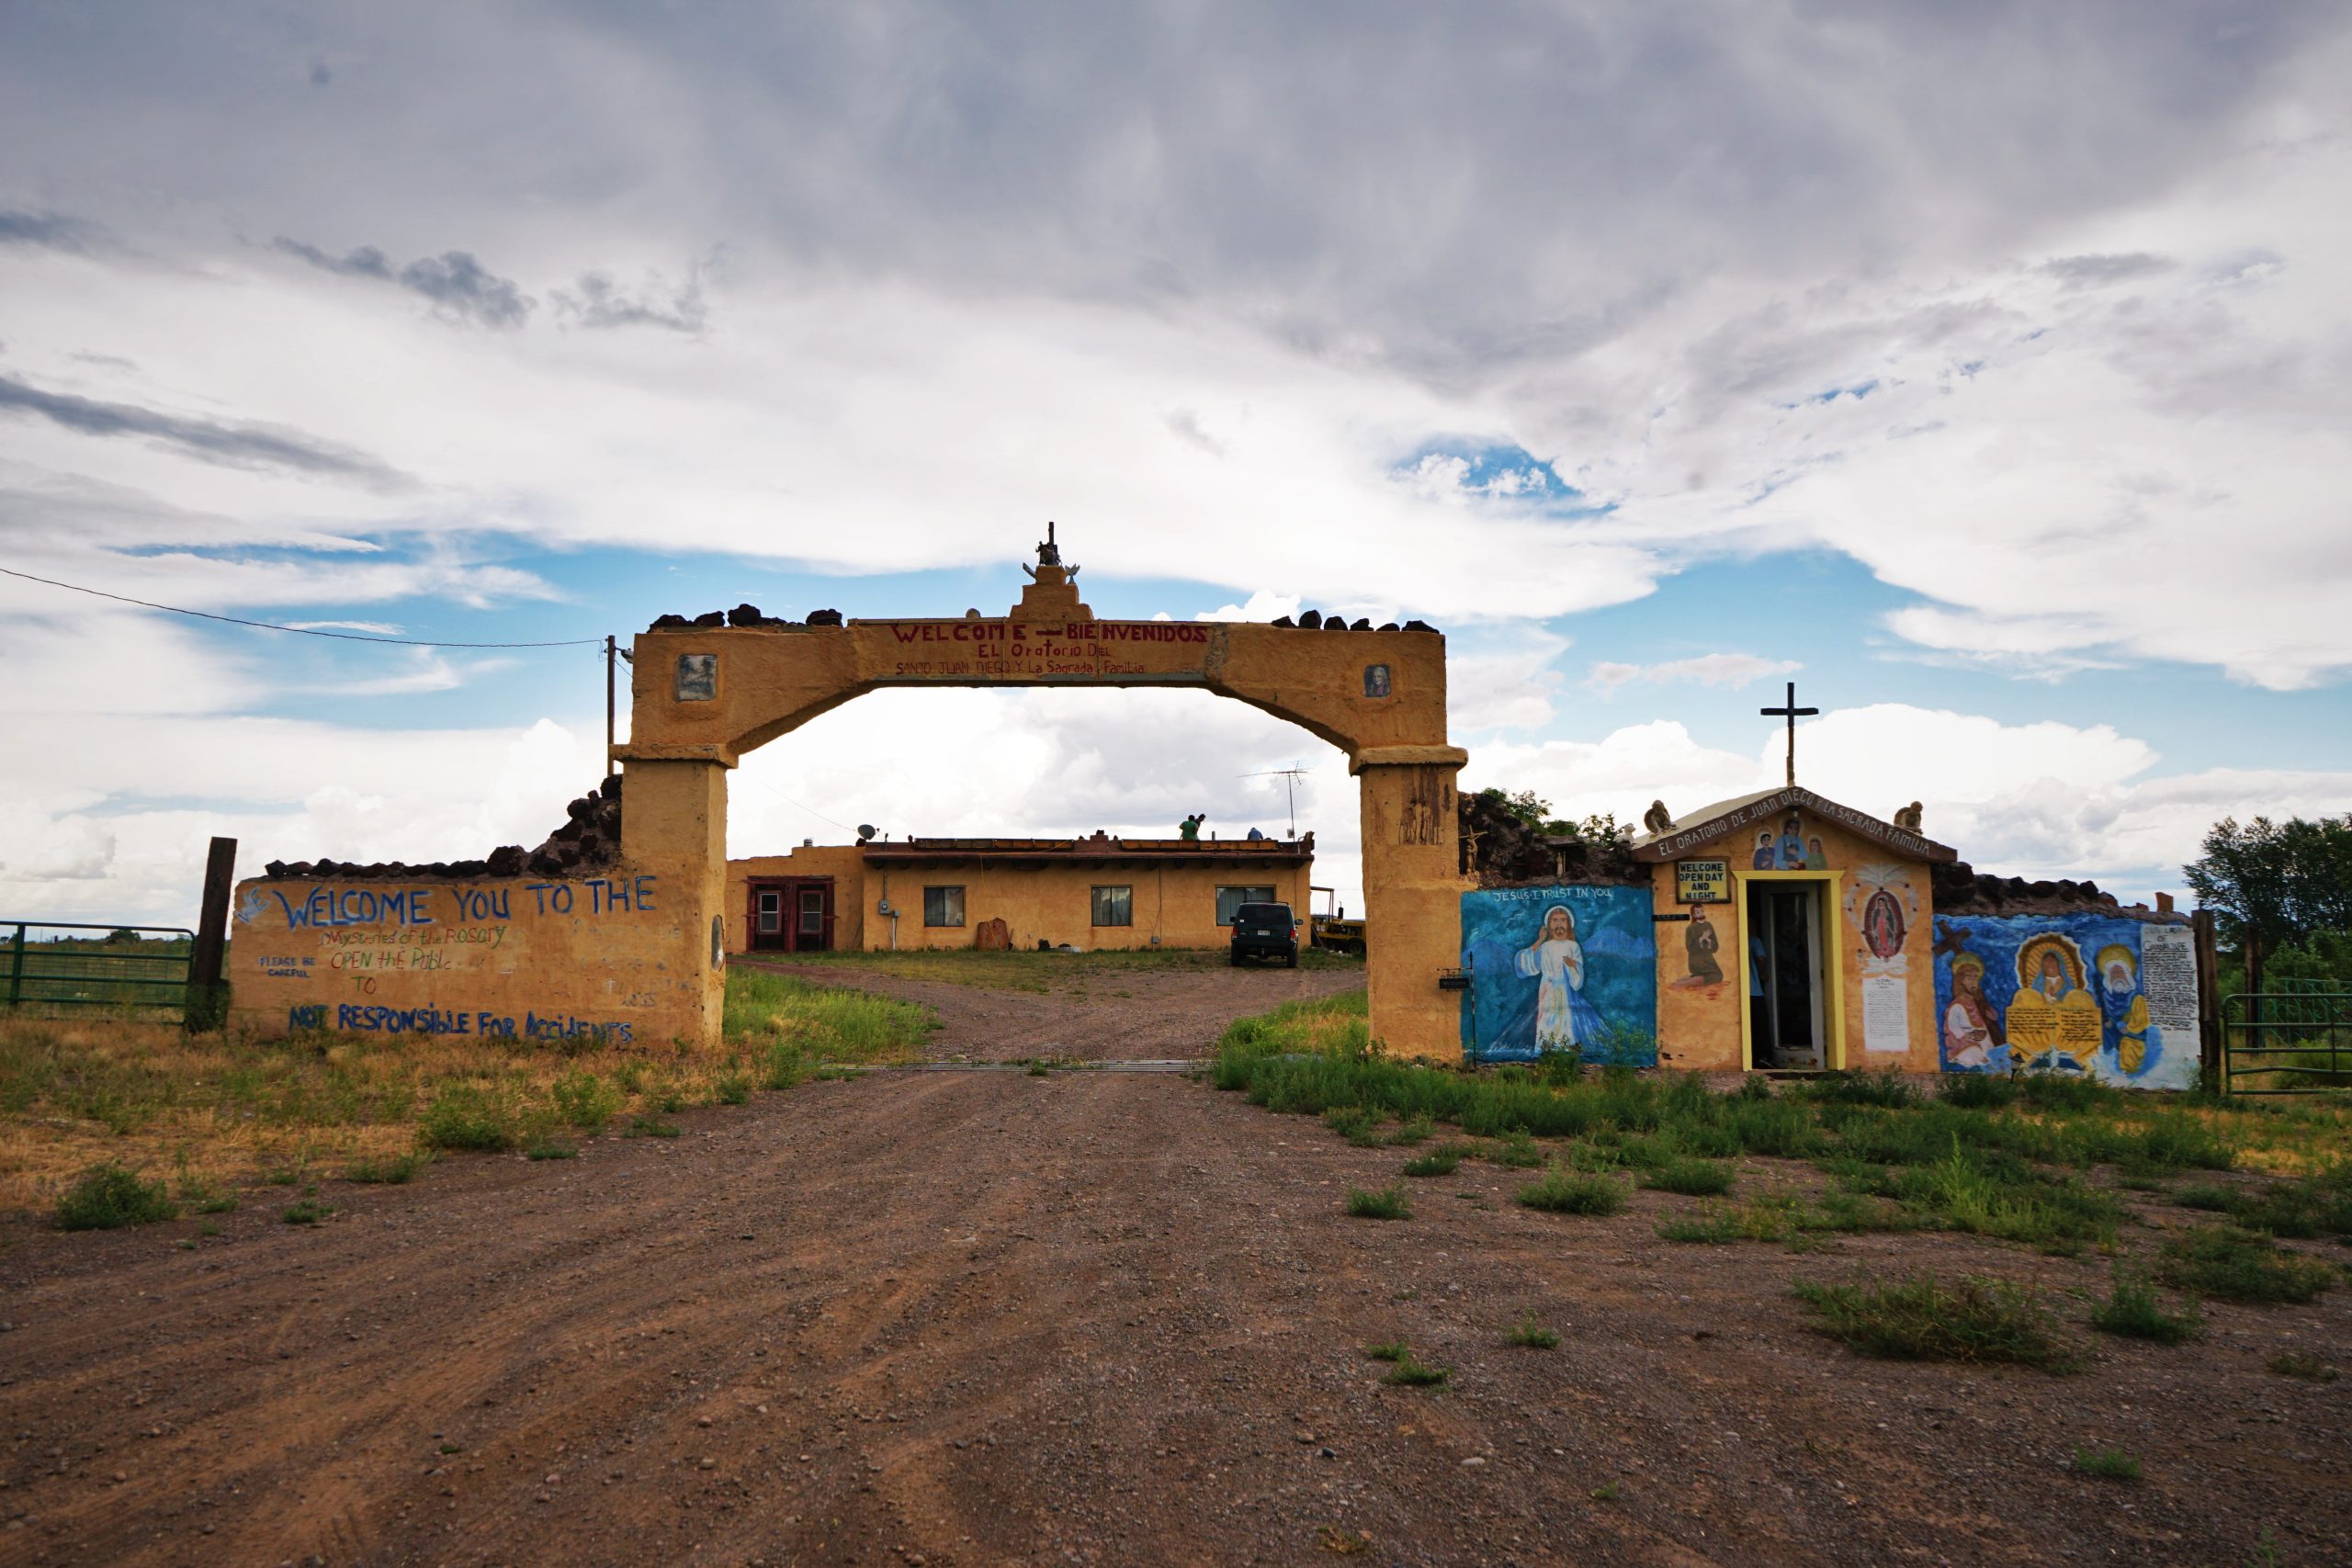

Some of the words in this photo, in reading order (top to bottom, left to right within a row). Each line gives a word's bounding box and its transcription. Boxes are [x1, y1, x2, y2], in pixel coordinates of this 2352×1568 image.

[890, 624, 1026, 643] WELCOME
[1067, 624, 1207, 643] BIENVENIDOS
[978, 644, 1000, 659] EL
[938, 661, 969, 674] JUAN
[1013, 660, 1023, 673] Y
[1046, 660, 1093, 675] Sagrada
[1657, 840, 1673, 856] EL
[1676, 819, 1728, 849] ORATORIO
[1731, 811, 1748, 828] DE
[1750, 798, 1779, 819] JUAN
[1824, 802, 1836, 817] LA
[1885, 827, 1930, 856] FAMILIA
[1679, 863, 1724, 873] WELCOME
[1679, 873, 1703, 882] OPEN
[1705, 873, 1724, 882] DAY
[1576, 888, 1589, 898] IN
[1590, 887, 1613, 899] YOU
[1691, 883, 1710, 891] AND
[272, 886, 437, 931] WELCOME
[452, 887, 512, 922] YOU
[525, 883, 574, 917] TO
[584, 875, 658, 916] THE
[419, 930, 442, 945] the
[258, 955, 298, 967] PLEASE
[301, 956, 316, 966] BE
[331, 951, 374, 970] OPEN
[267, 968, 311, 978] CAREFUL
[351, 976, 377, 995] TO
[288, 1004, 329, 1032] NOT
[478, 1011, 515, 1039] FOR
